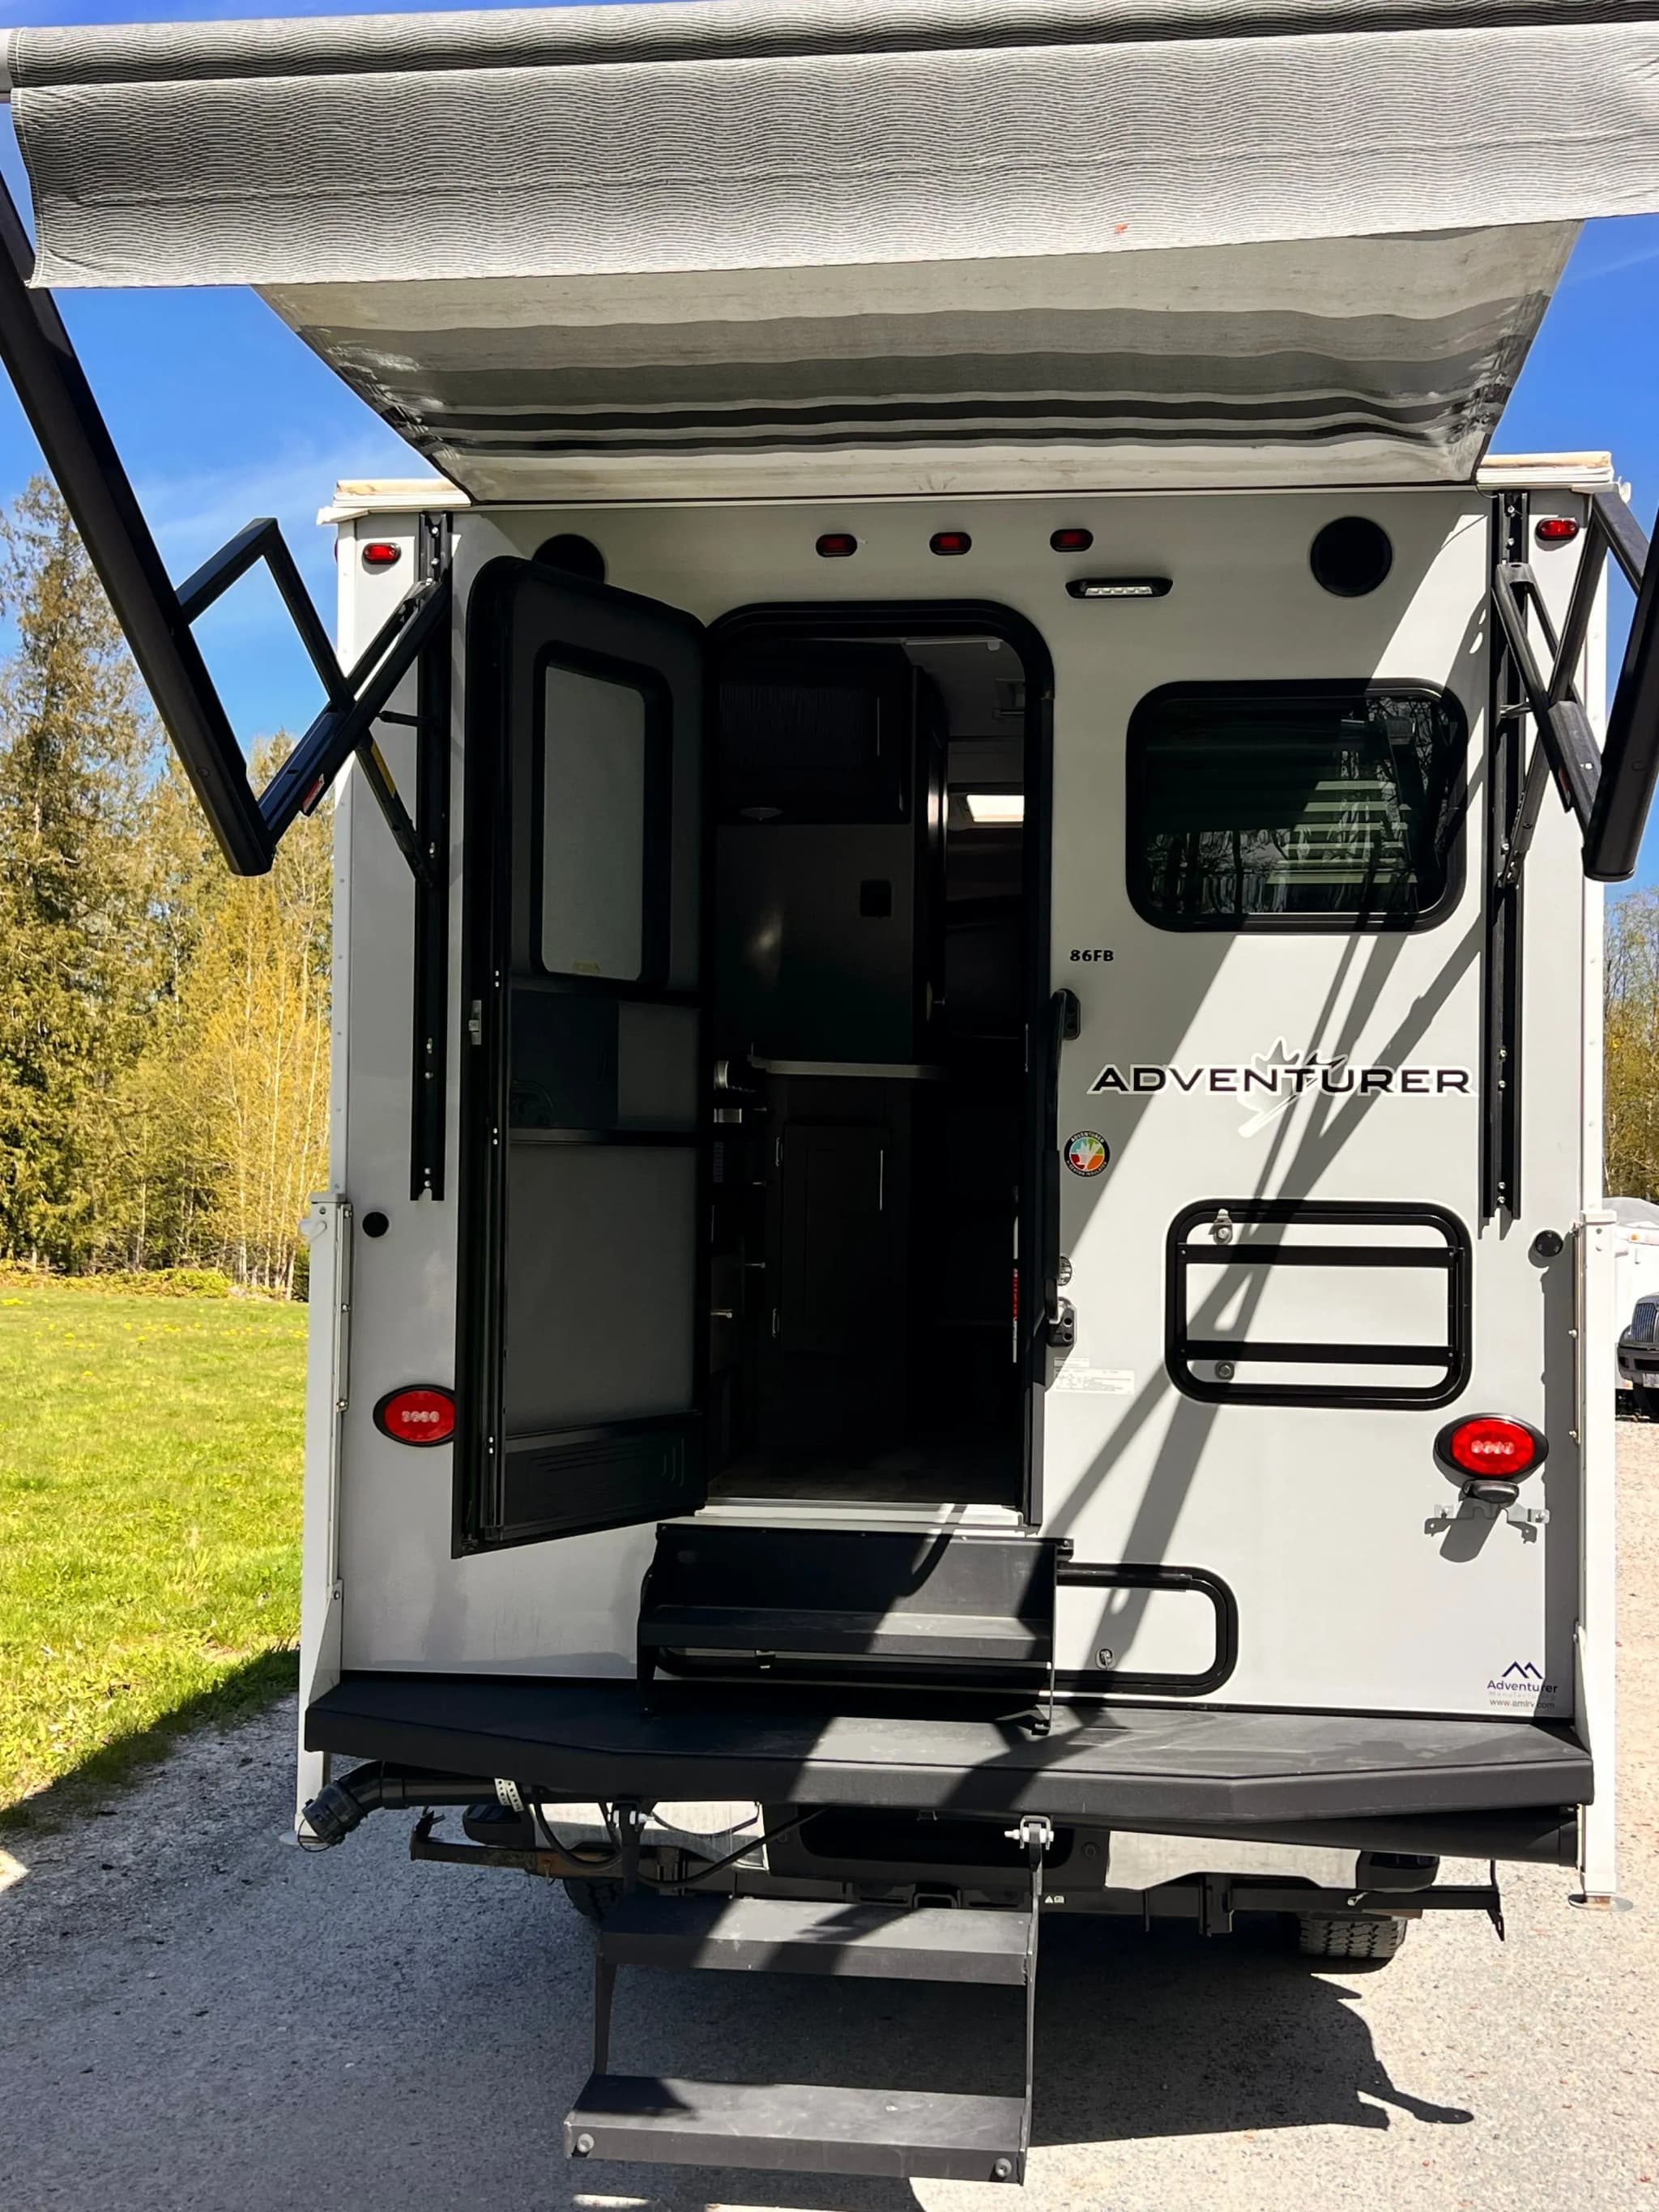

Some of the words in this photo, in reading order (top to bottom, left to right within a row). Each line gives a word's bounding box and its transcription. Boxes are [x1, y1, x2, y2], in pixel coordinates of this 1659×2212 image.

[1070, 949, 1114, 961] 86FB
[1092, 1064, 1472, 1093] ADVENTURER
[1487, 1680, 1558, 1693] Adventurer
